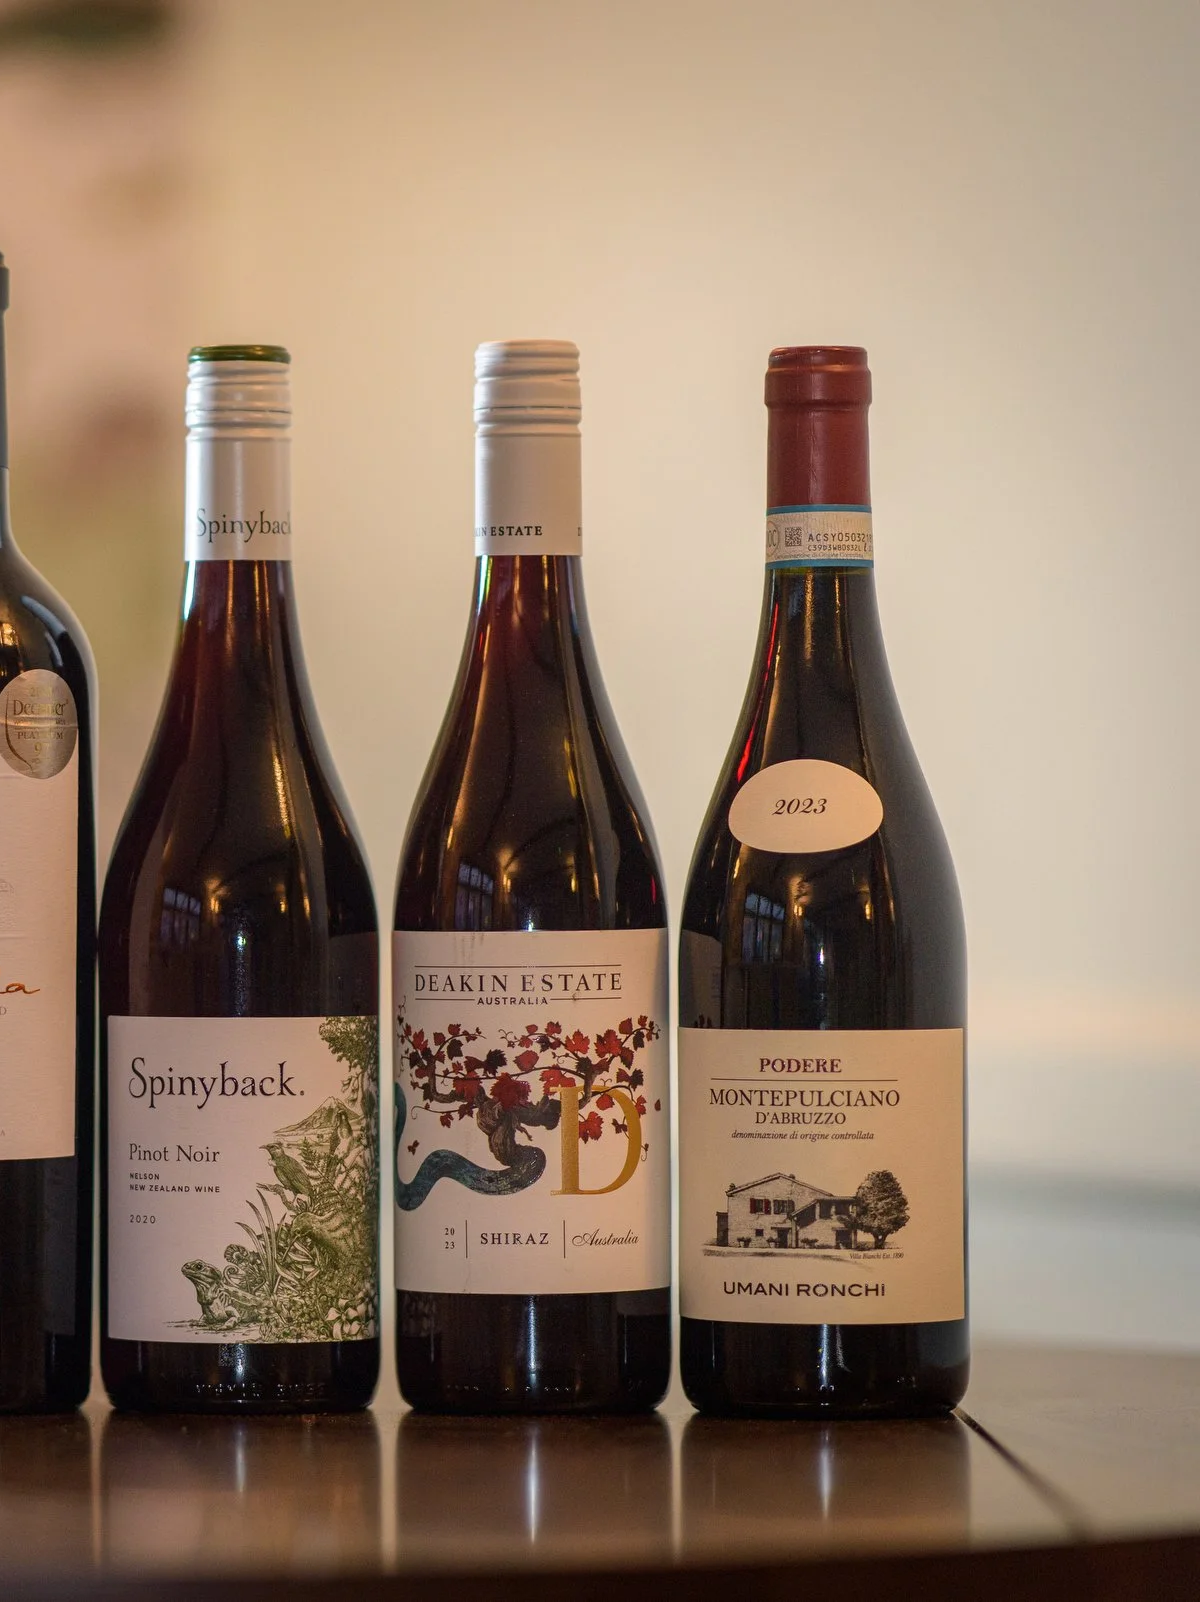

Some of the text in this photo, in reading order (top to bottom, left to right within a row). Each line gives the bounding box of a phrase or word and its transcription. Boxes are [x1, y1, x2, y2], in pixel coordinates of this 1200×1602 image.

[490, 526, 543, 536] ESTATE
[772, 797, 827, 816] 2023
[415, 973, 622, 992] DEAKIN ESTATE
[477, 997, 548, 1006] AUSTRALIA
[759, 1058, 842, 1073] PODERE
[709, 1088, 900, 1107] MONTEPULCIANO
[755, 1112, 847, 1125] D'ABRUZZO
[731, 1130, 875, 1142] denominazione di origine controllata
[129, 1143, 220, 1162] Pinot Noir
[130, 1214, 156, 1224] 2020
[444, 1227, 455, 1236] 20
[572, 1227, 639, 1247] Australia
[480, 1232, 549, 1245] SHIRAZ
[444, 1241, 455, 1250] 23
[723, 1281, 885, 1297] UMANI RONCHI
